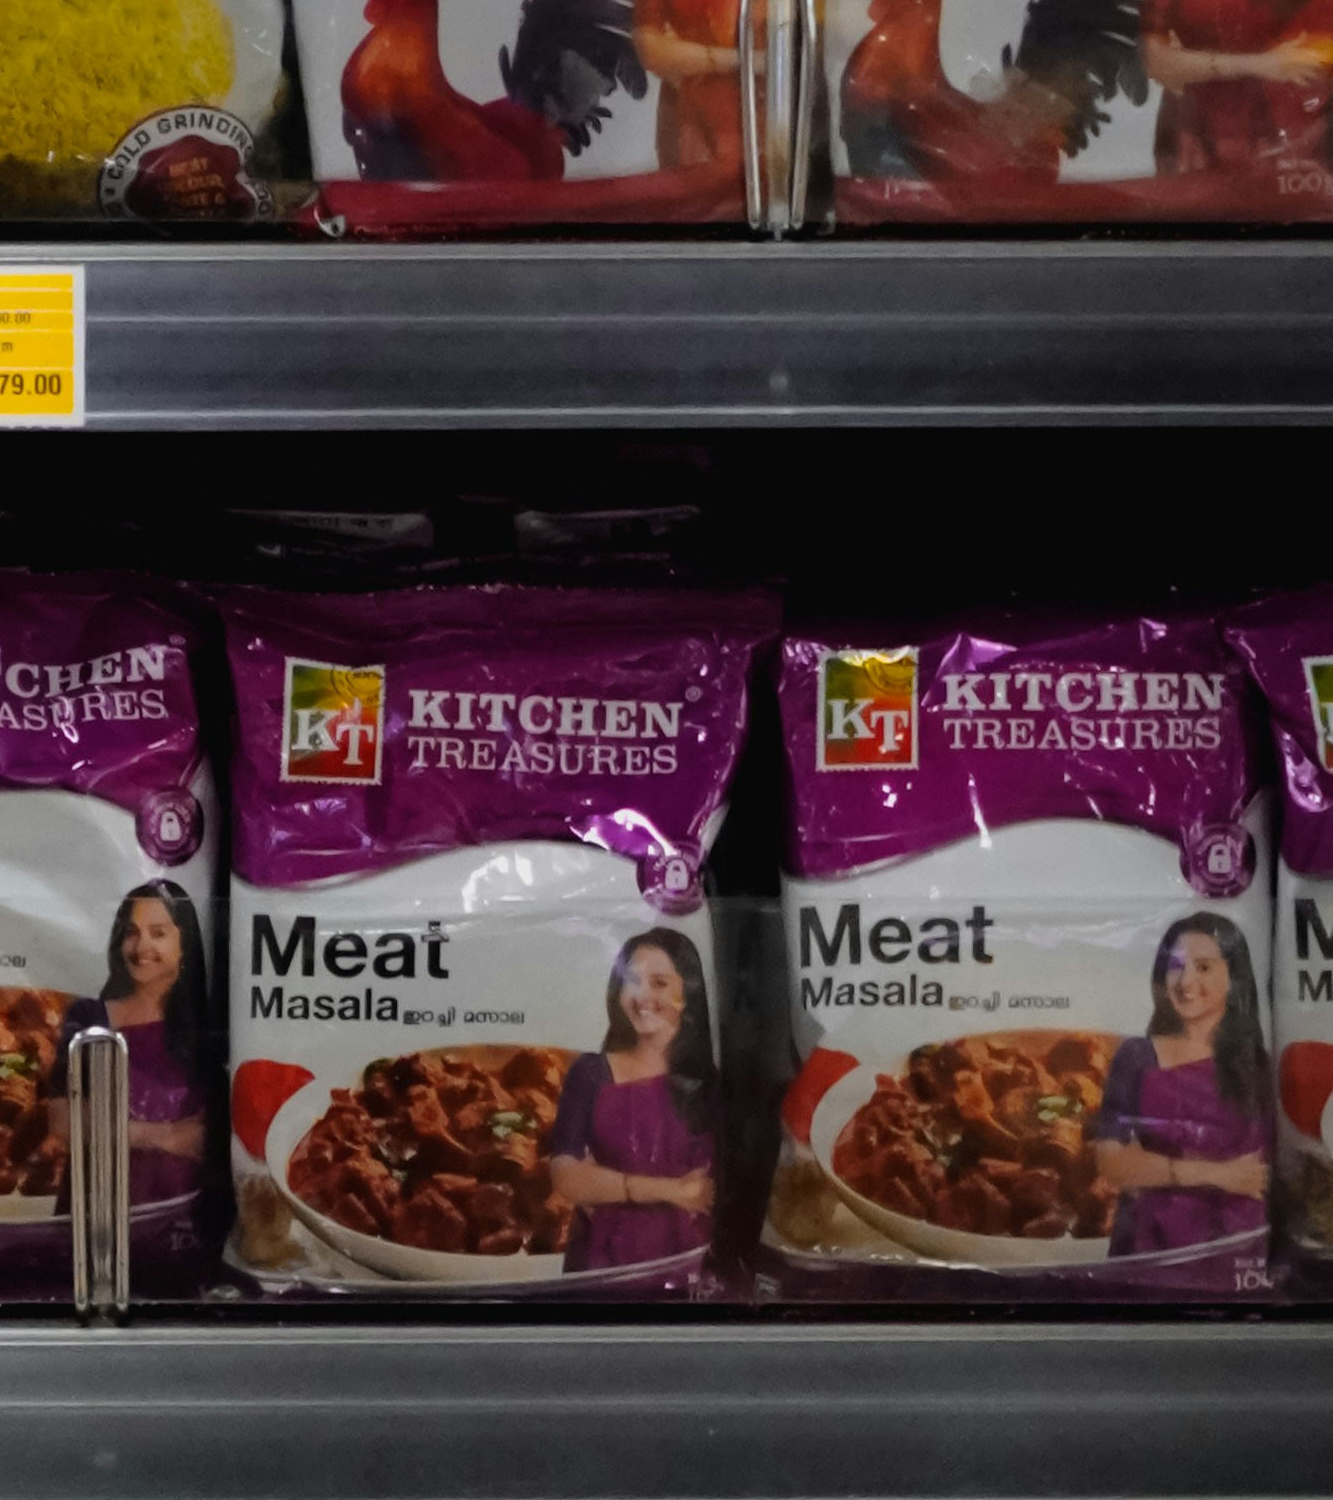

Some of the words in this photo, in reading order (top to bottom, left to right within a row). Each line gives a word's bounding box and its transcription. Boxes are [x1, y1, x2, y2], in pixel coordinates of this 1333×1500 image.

[292, 710, 374, 767] KT
[409, 689, 685, 740] KITCHEN
[409, 736, 680, 777] TREASURES
[249, 914, 450, 980] Meat
[800, 903, 993, 967] Meat
[249, 988, 399, 1021] Masala
